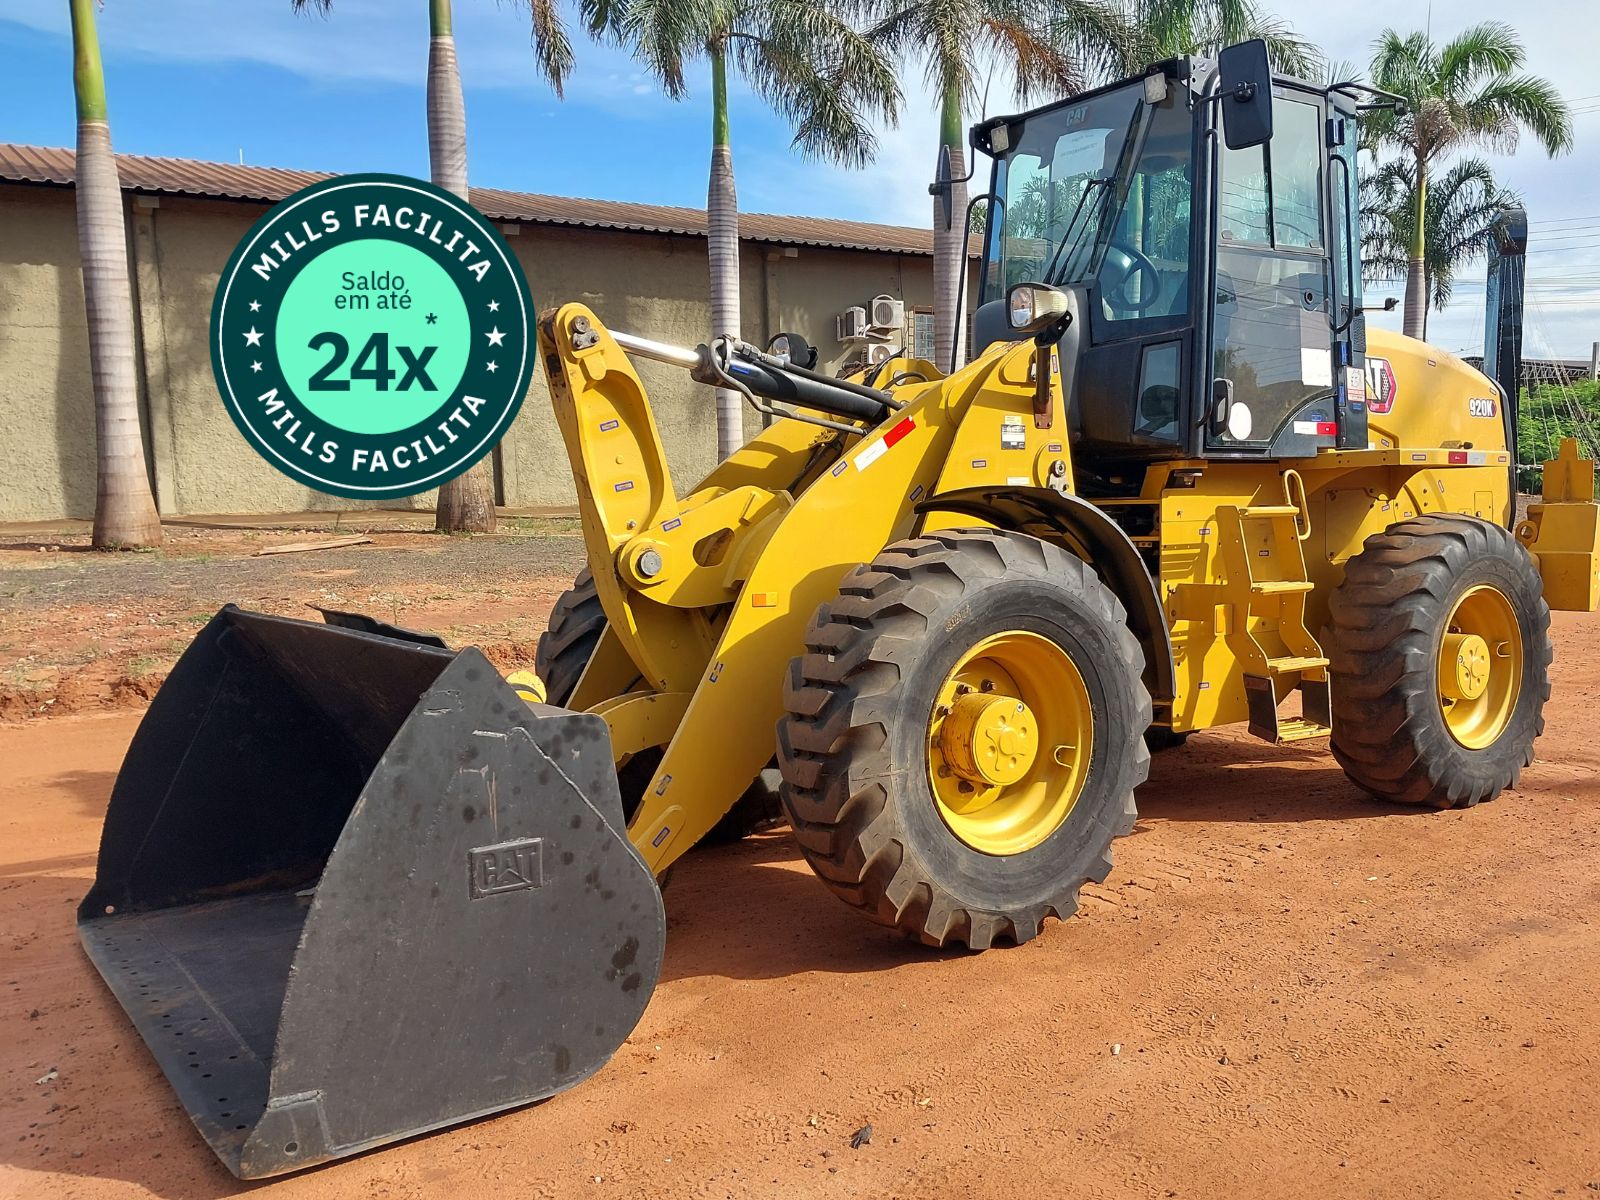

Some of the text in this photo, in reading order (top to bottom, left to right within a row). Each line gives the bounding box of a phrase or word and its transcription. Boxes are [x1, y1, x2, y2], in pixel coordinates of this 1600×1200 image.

[1067, 106, 1088, 127] CAT
[1365, 358, 1384, 400] AT
[1469, 399, 1493, 417] 920K
[477, 845, 537, 892] CAT
